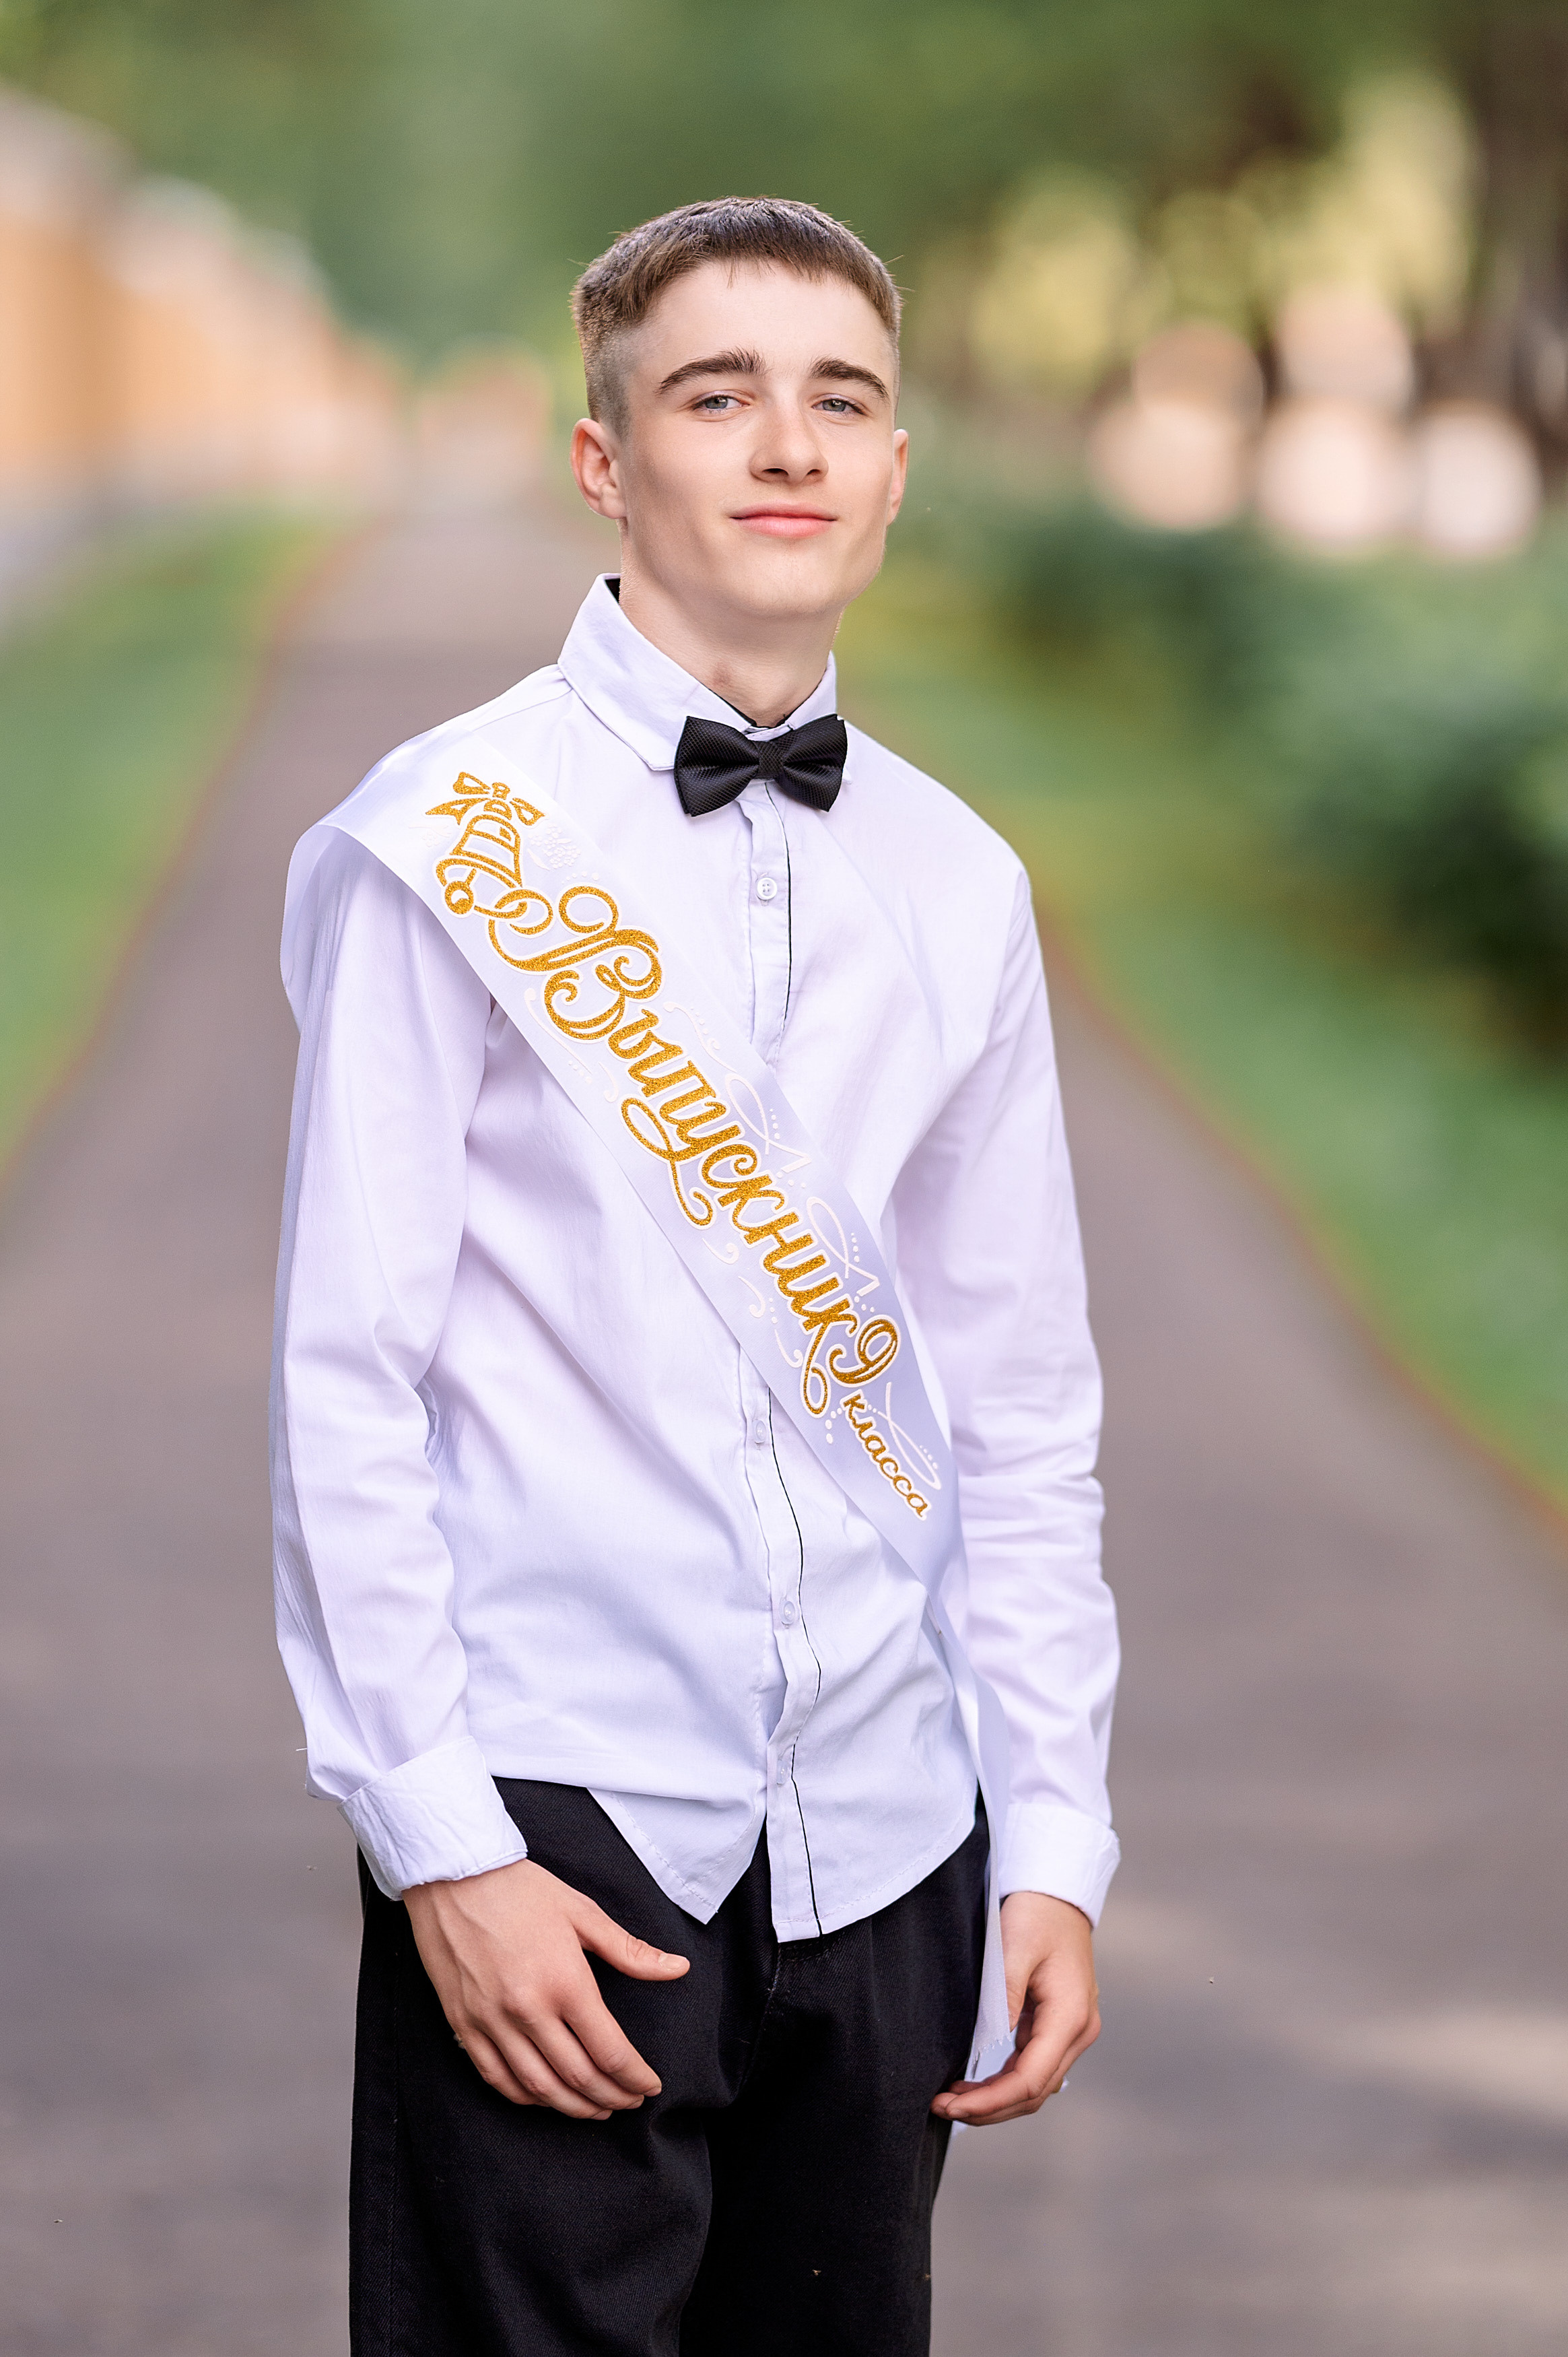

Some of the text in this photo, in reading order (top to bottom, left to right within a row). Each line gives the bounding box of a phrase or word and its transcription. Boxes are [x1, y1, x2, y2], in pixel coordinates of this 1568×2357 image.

[487, 885, 928, 1517] Выпускник 9 класса
